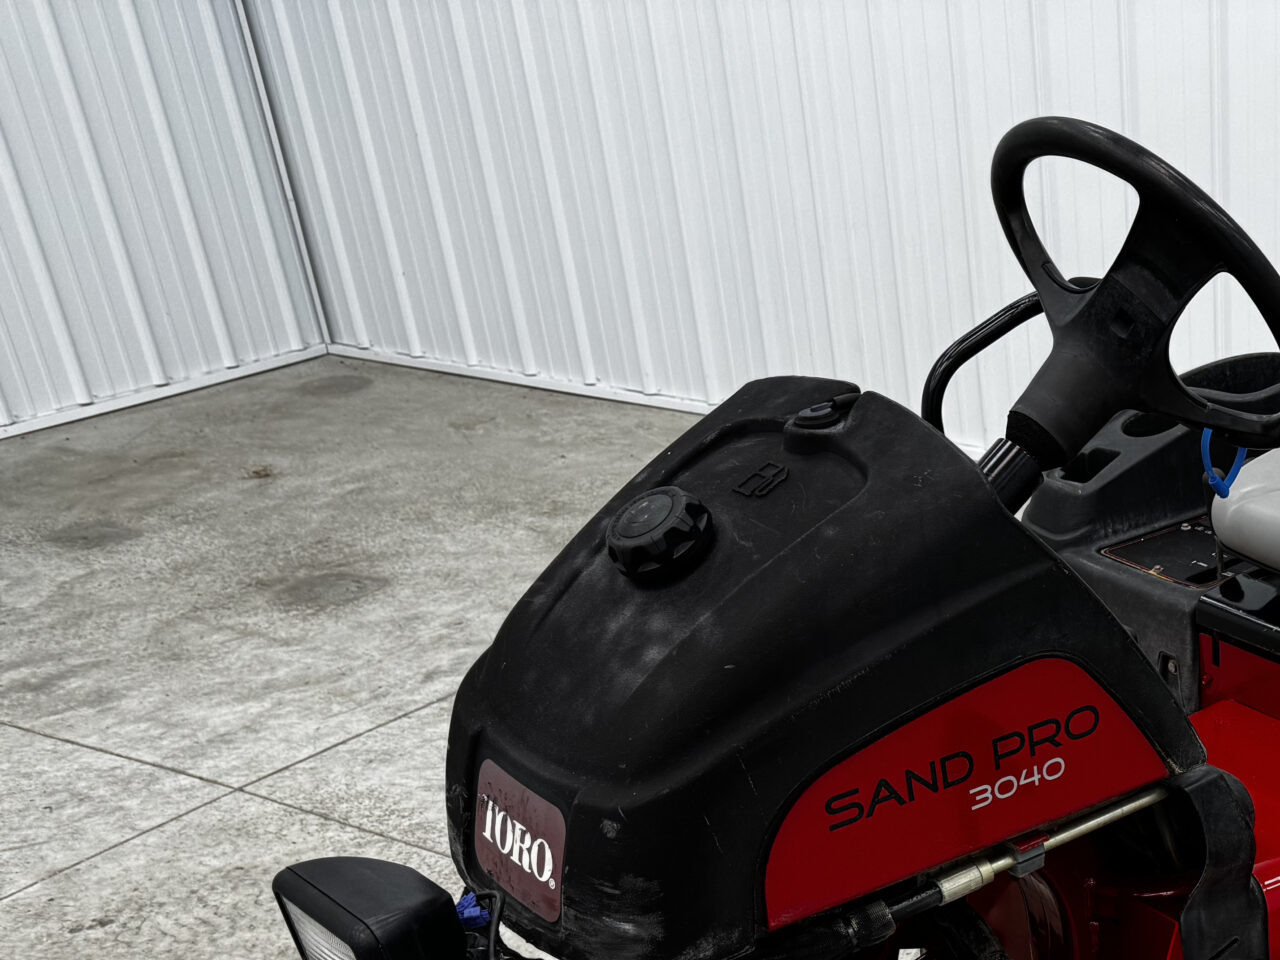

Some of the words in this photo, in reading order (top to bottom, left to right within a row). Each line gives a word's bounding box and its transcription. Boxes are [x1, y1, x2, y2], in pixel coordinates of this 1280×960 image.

[825, 751, 974, 832] SAND
[993, 705, 1100, 770] PRO
[969, 758, 1065, 811] 3040
[480, 795, 553, 882] TORO
